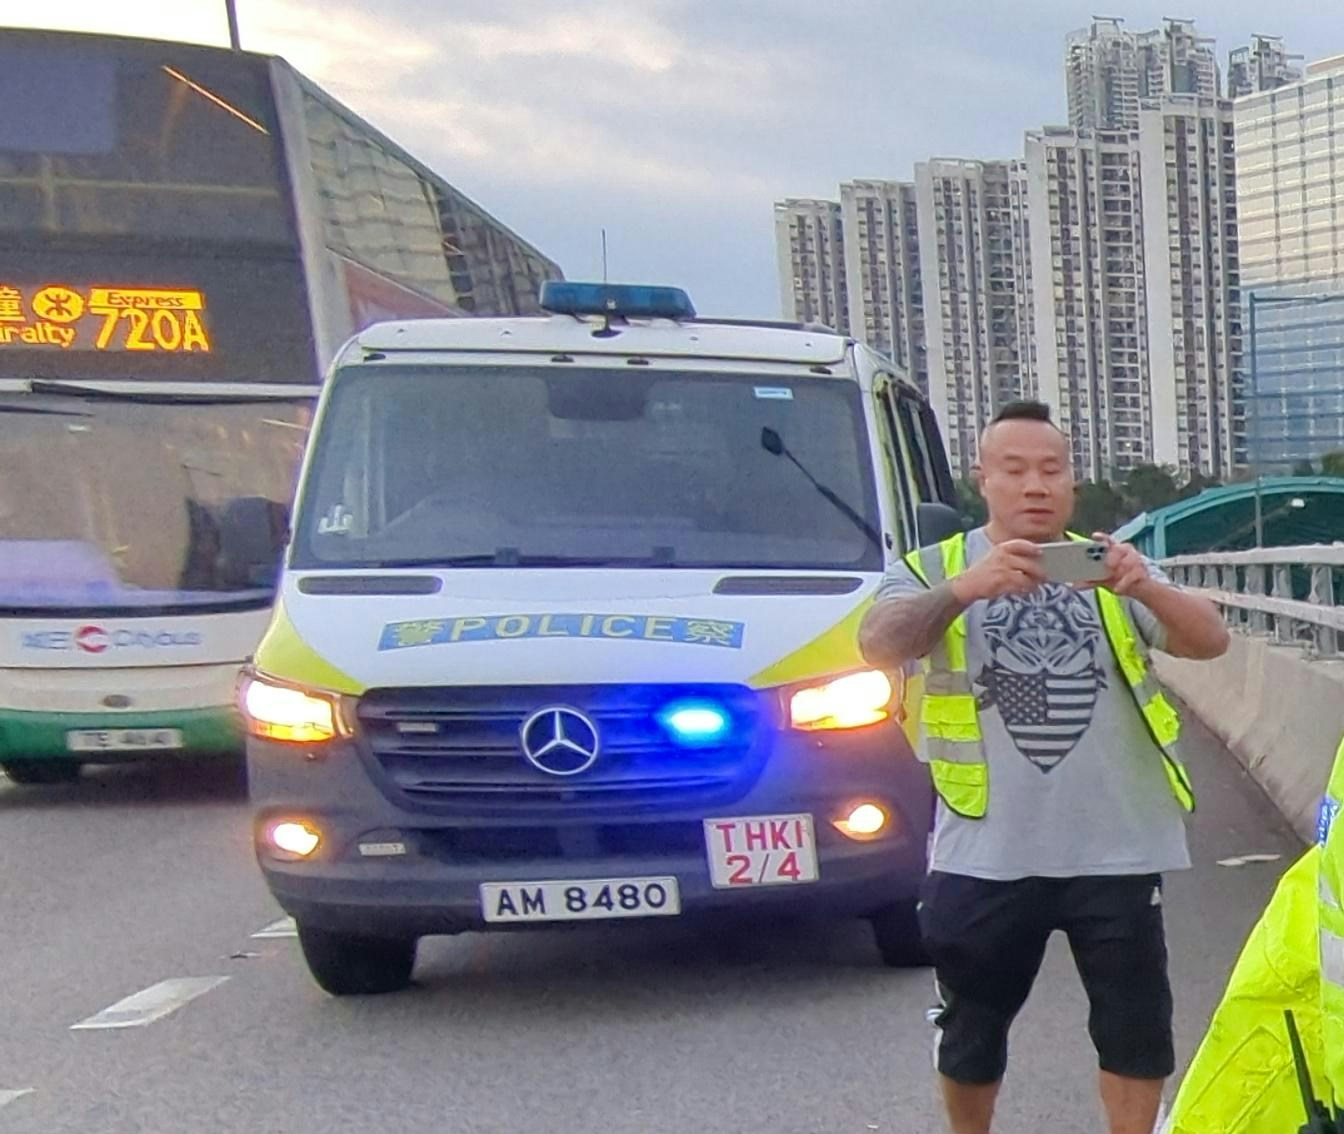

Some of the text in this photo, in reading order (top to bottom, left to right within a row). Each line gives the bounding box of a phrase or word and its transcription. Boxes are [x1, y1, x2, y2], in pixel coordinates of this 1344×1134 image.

[107, 291, 184, 308] Express
[90, 308, 210, 351] 720A
[450, 614, 678, 641] POLICE
[725, 852, 802, 885] 2/4
[496, 883, 667, 917] AM 8480
